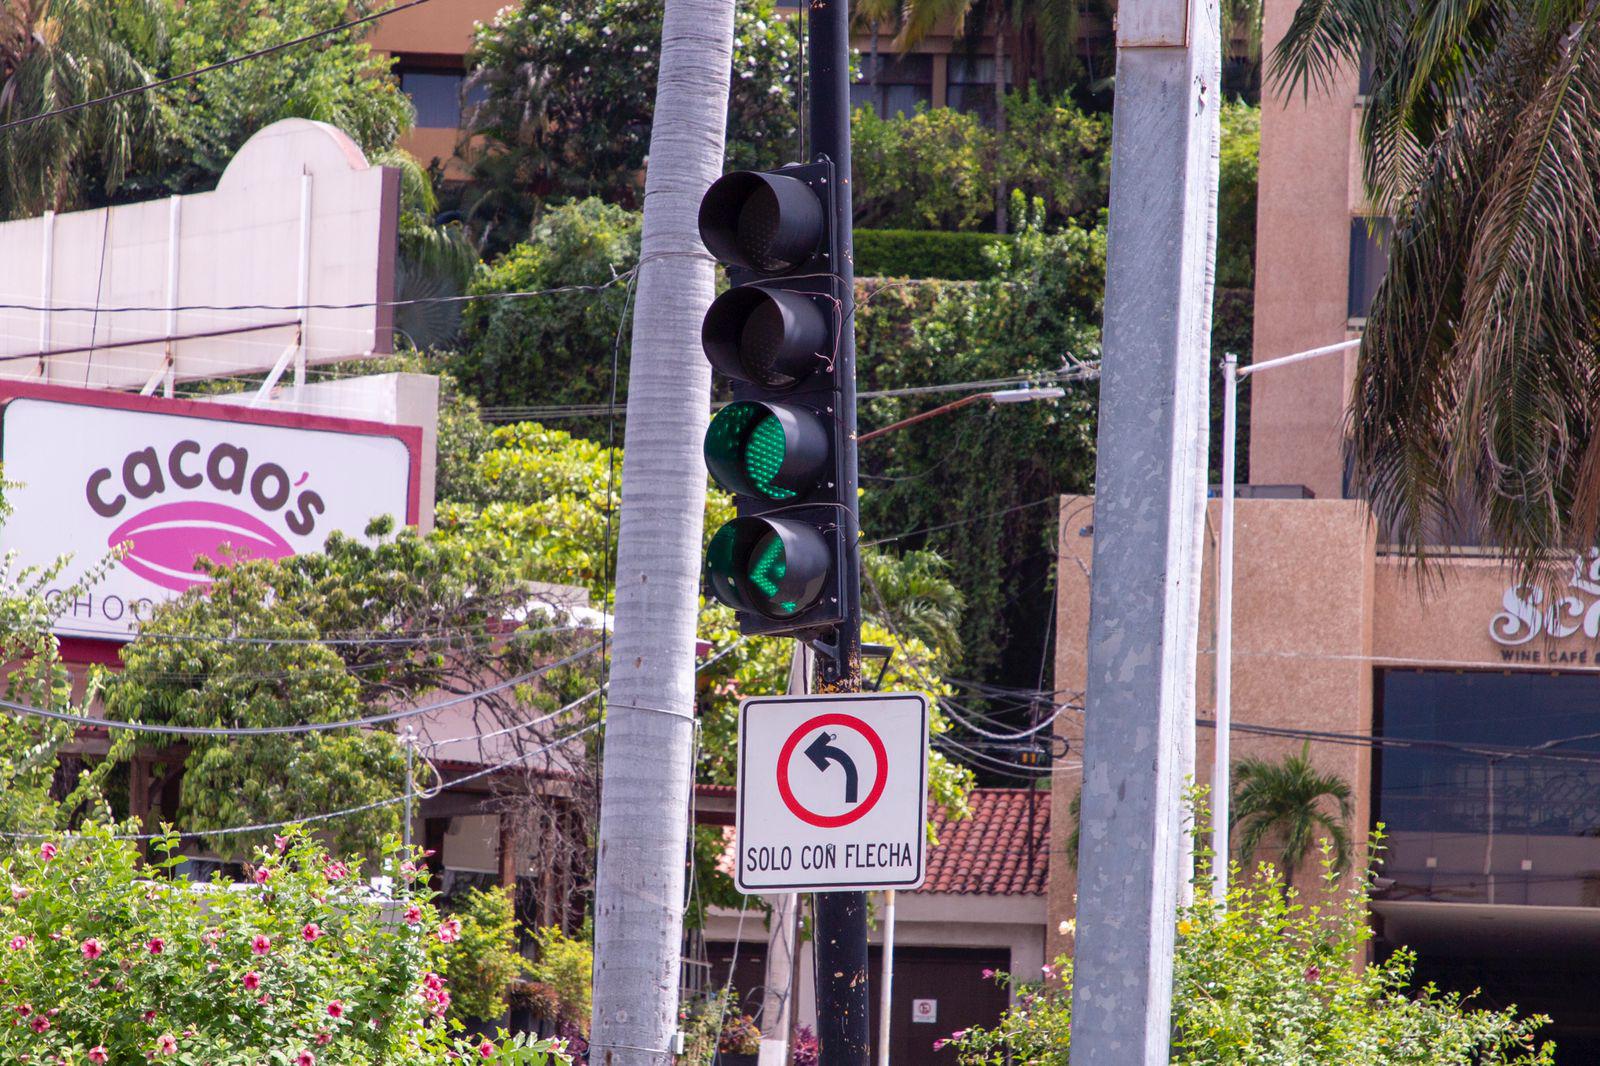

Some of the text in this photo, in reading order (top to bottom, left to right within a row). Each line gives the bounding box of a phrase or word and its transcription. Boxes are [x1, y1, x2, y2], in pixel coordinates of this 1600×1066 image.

[86, 440, 325, 536] cacao's
[1501, 650, 1541, 662] WINE
[1549, 649, 1587, 664] CAFÉ
[746, 843, 913, 872] SOLO CON FLECHA
